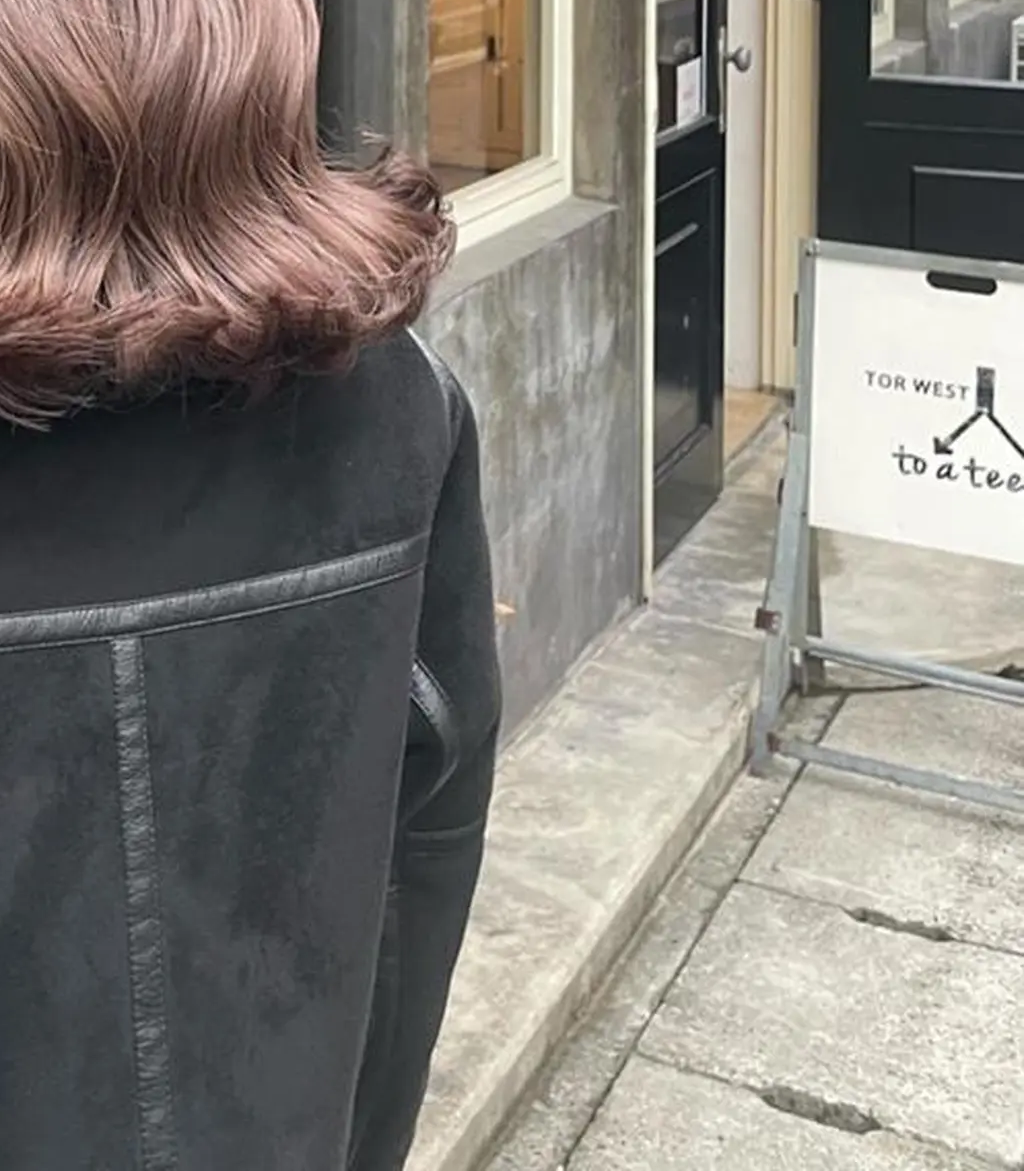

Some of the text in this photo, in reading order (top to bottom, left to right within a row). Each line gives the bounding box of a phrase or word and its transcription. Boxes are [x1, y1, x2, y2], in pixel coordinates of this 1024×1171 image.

[865, 370, 970, 401] TOR WEST
[891, 444, 928, 476] to
[962, 456, 1024, 493] tee
